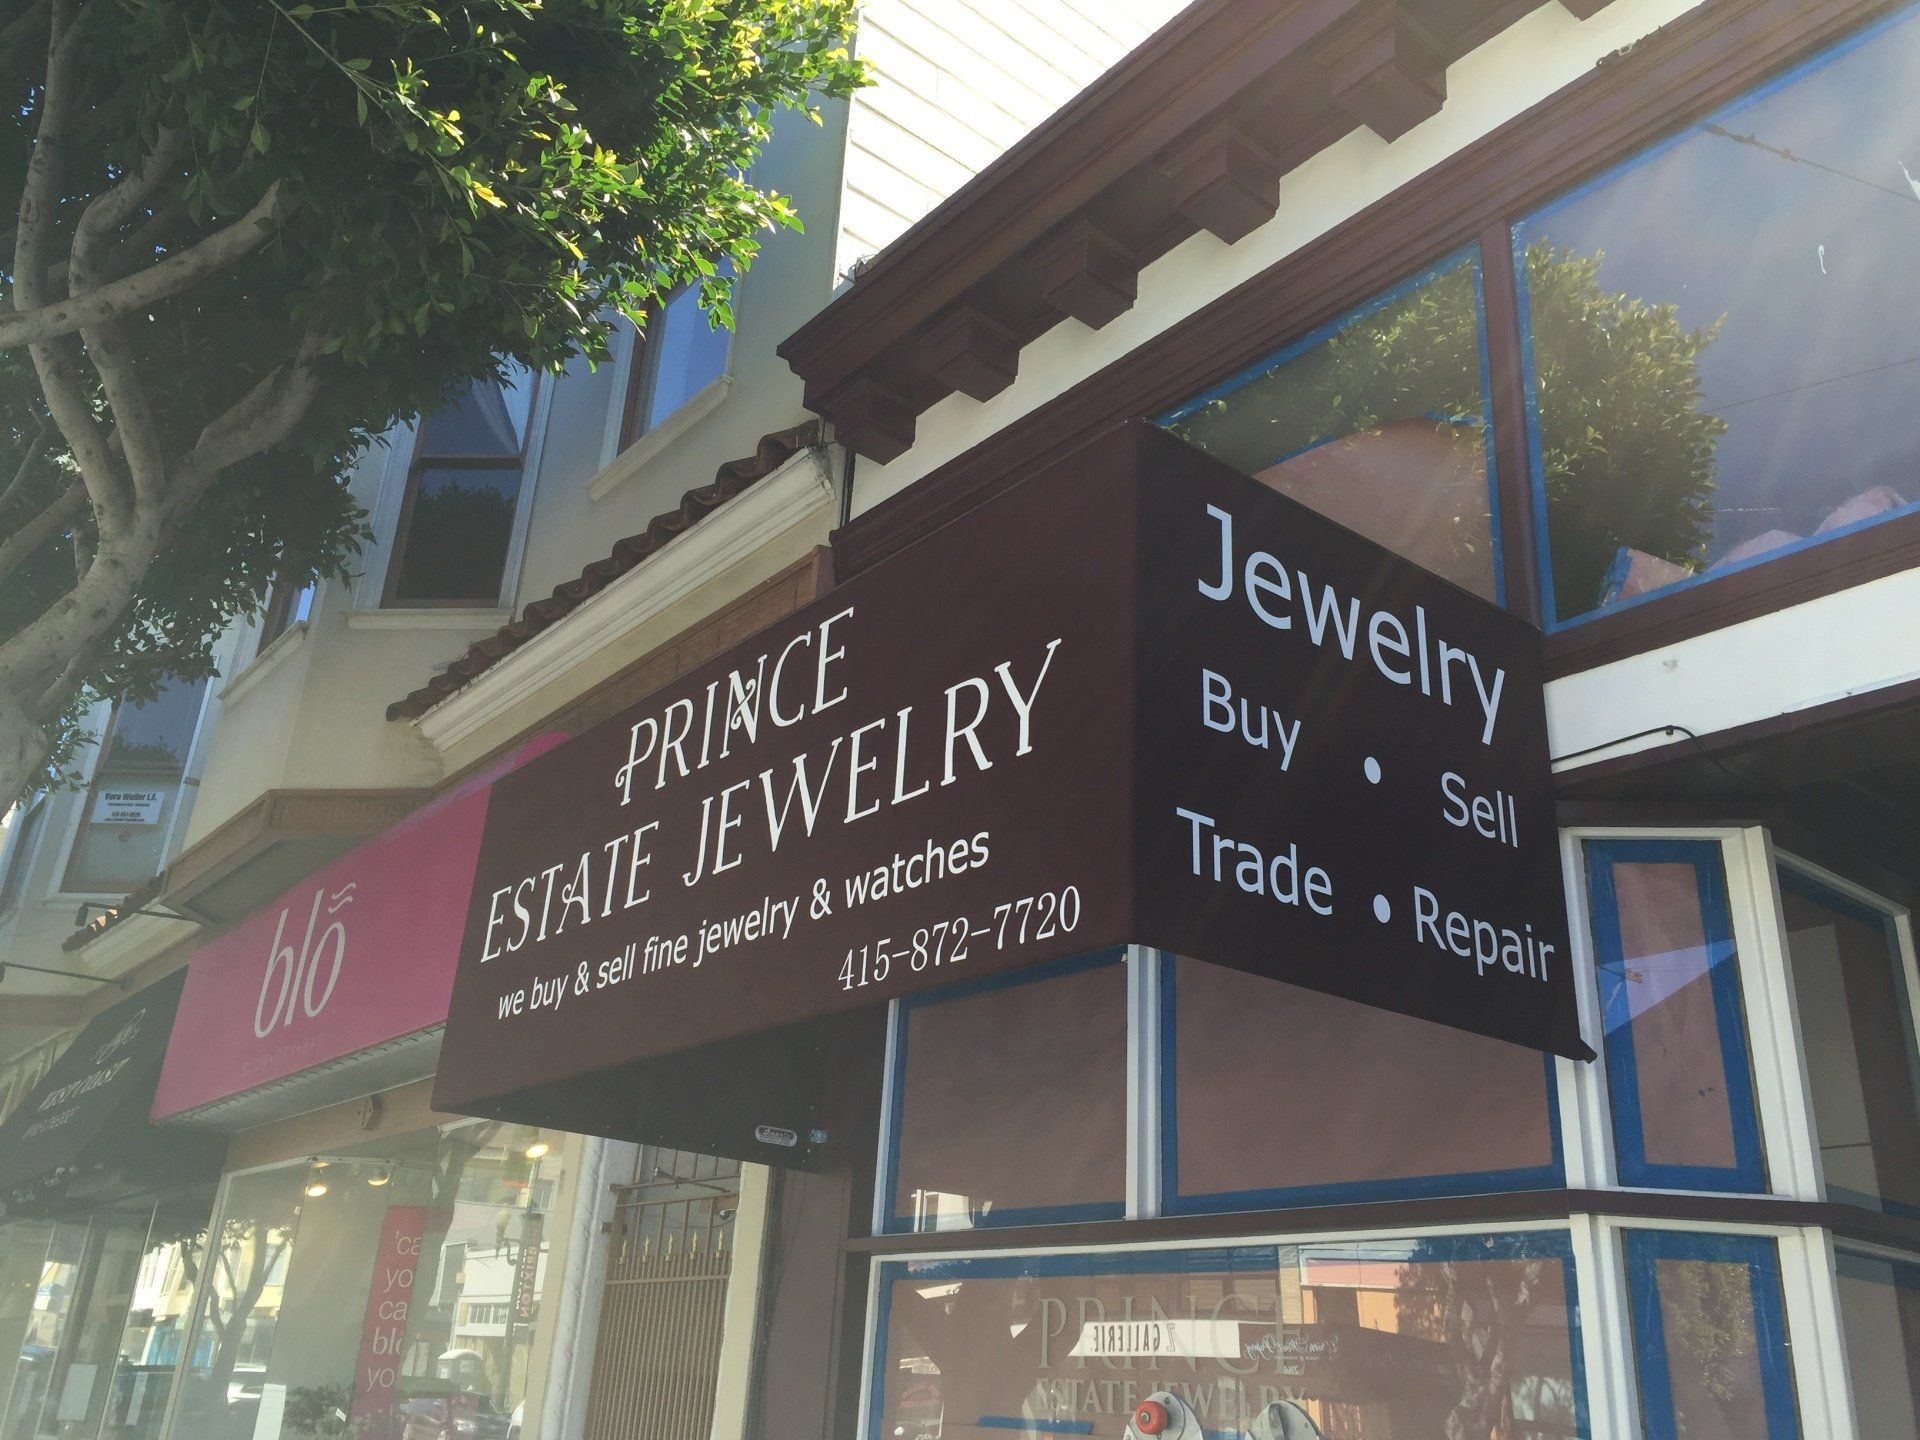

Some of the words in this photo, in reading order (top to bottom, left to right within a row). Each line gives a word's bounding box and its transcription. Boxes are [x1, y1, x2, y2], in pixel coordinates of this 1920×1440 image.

[615, 606, 856, 807] PRINCE
[1198, 503, 1506, 746] Jewelry
[480, 820, 660, 963] ESTATE
[682, 637, 1063, 888] JEWELRY
[1202, 667, 1302, 772] Buy
[1441, 771, 1519, 849] Sell
[498, 989, 525, 1020] we
[529, 972, 570, 1013] buy
[573, 961, 590, 996] &
[596, 942, 637, 989] sell
[642, 923, 689, 975] fine
[692, 892, 800, 968] jewelry
[809, 877, 833, 920] &
[845, 831, 991, 909] watches
[837, 885, 1081, 991] 415-872-7720
[1176, 806, 1333, 916] Trade
[1413, 885, 1556, 982] Repair
[1035, 1377, 1138, 1416] ESTATE
[1038, 1292, 1306, 1376] PRINCE
